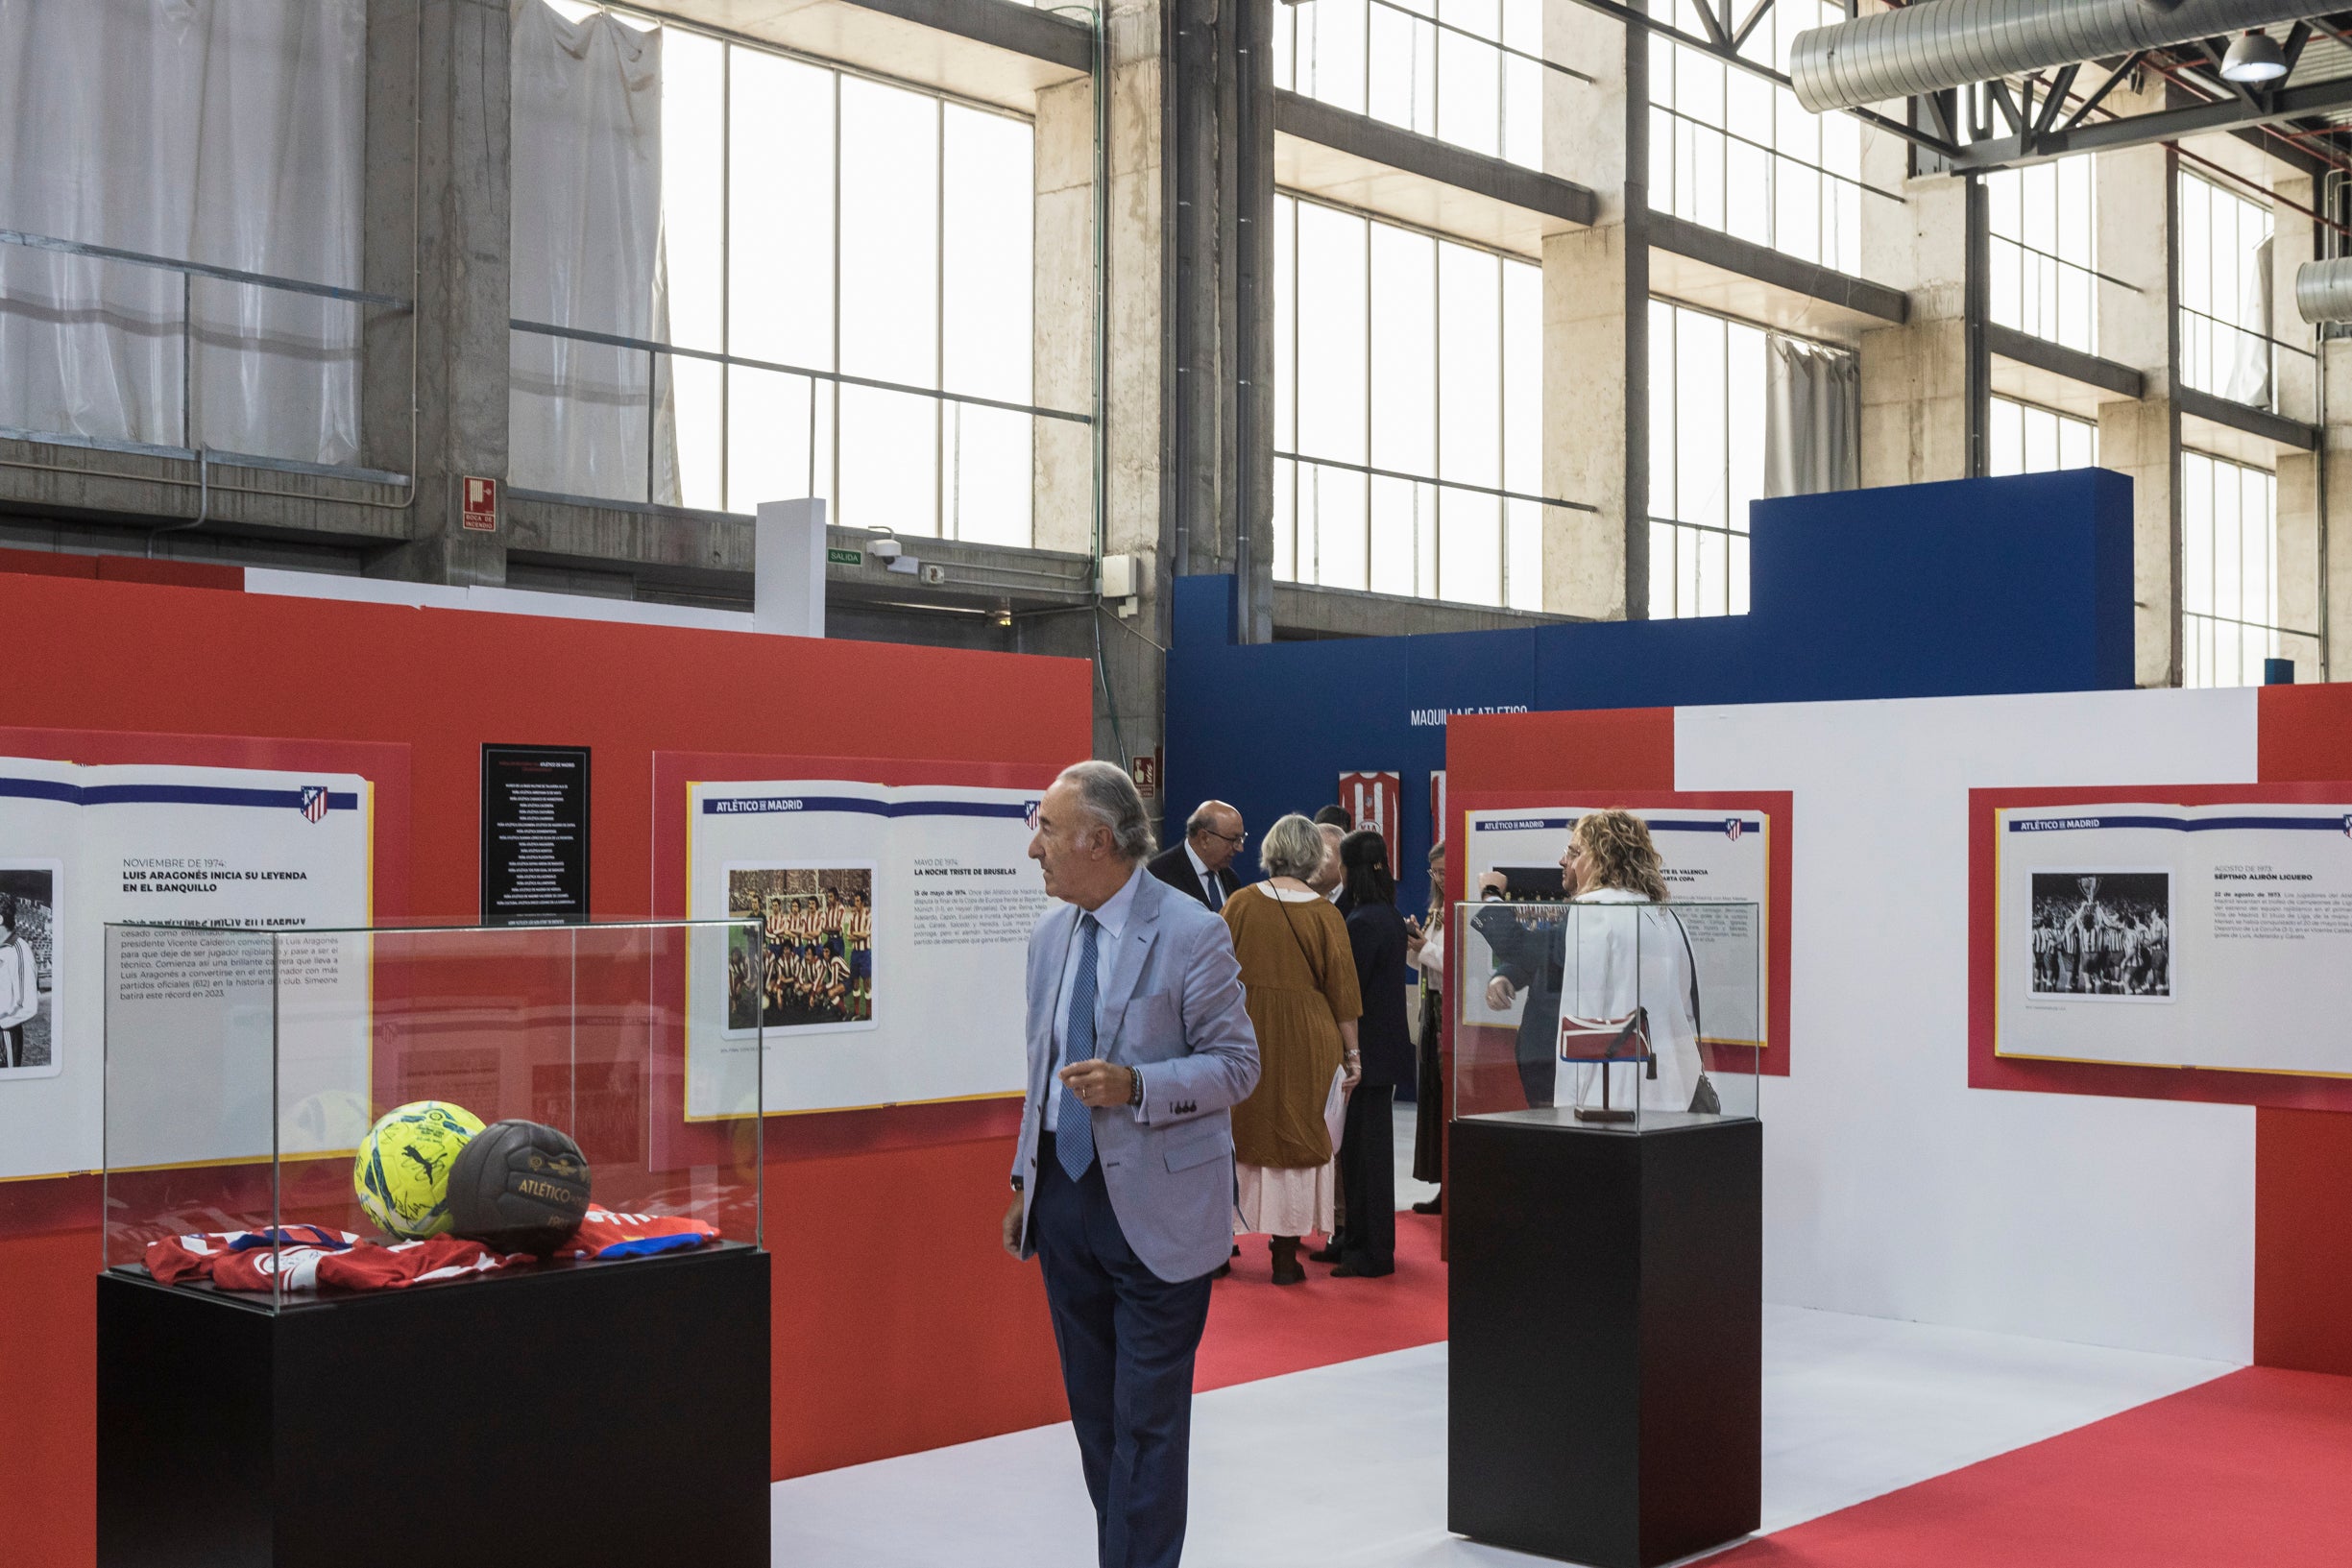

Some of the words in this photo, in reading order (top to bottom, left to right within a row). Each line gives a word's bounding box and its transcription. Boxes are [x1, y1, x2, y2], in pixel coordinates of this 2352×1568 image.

[831, 551, 859, 562] SALIDA
[716, 799, 759, 812] ATLÉTICO
[767, 799, 803, 810] MADRID
[1484, 822, 1514, 831] ATLÉTICO
[1519, 820, 1545, 829] MADRID
[2021, 820, 2058, 831] ATLÉTICO
[2067, 818, 2100, 829] MADRID
[123, 858, 185, 868] NOVIEMBRE
[187, 858, 203, 868] DE
[123, 871, 147, 880] LUIS
[149, 869, 208, 880] ARAGONÉS
[210, 871, 243, 880] INICIA
[245, 871, 258, 880] SU
[261, 871, 307, 880] LEYENDA
[123, 883, 137, 892] EN
[140, 883, 153, 892] EL
[156, 883, 217, 893] BANQUILLO
[121, 929, 151, 938] cesado
[121, 940, 165, 949] presidente
[167, 939, 198, 948] Vicente
[303, 937, 339, 947] Aragonés
[121, 951, 140, 959] para
[159, 950, 179, 958] deje
[207, 949, 239, 957] jugador
[140, 971, 180, 979] Aragonés
[188, 969, 233, 977] convertirse
[121, 981, 155, 991] partidos
[157, 980, 190, 989] oficiales
[192, 979, 211, 988] (612)
[235, 978, 265, 987] historia
[303, 976, 338, 984] Simeone
[121, 991, 144, 1001] batirá
[519, 1178, 570, 1202] ATLÉTICO
